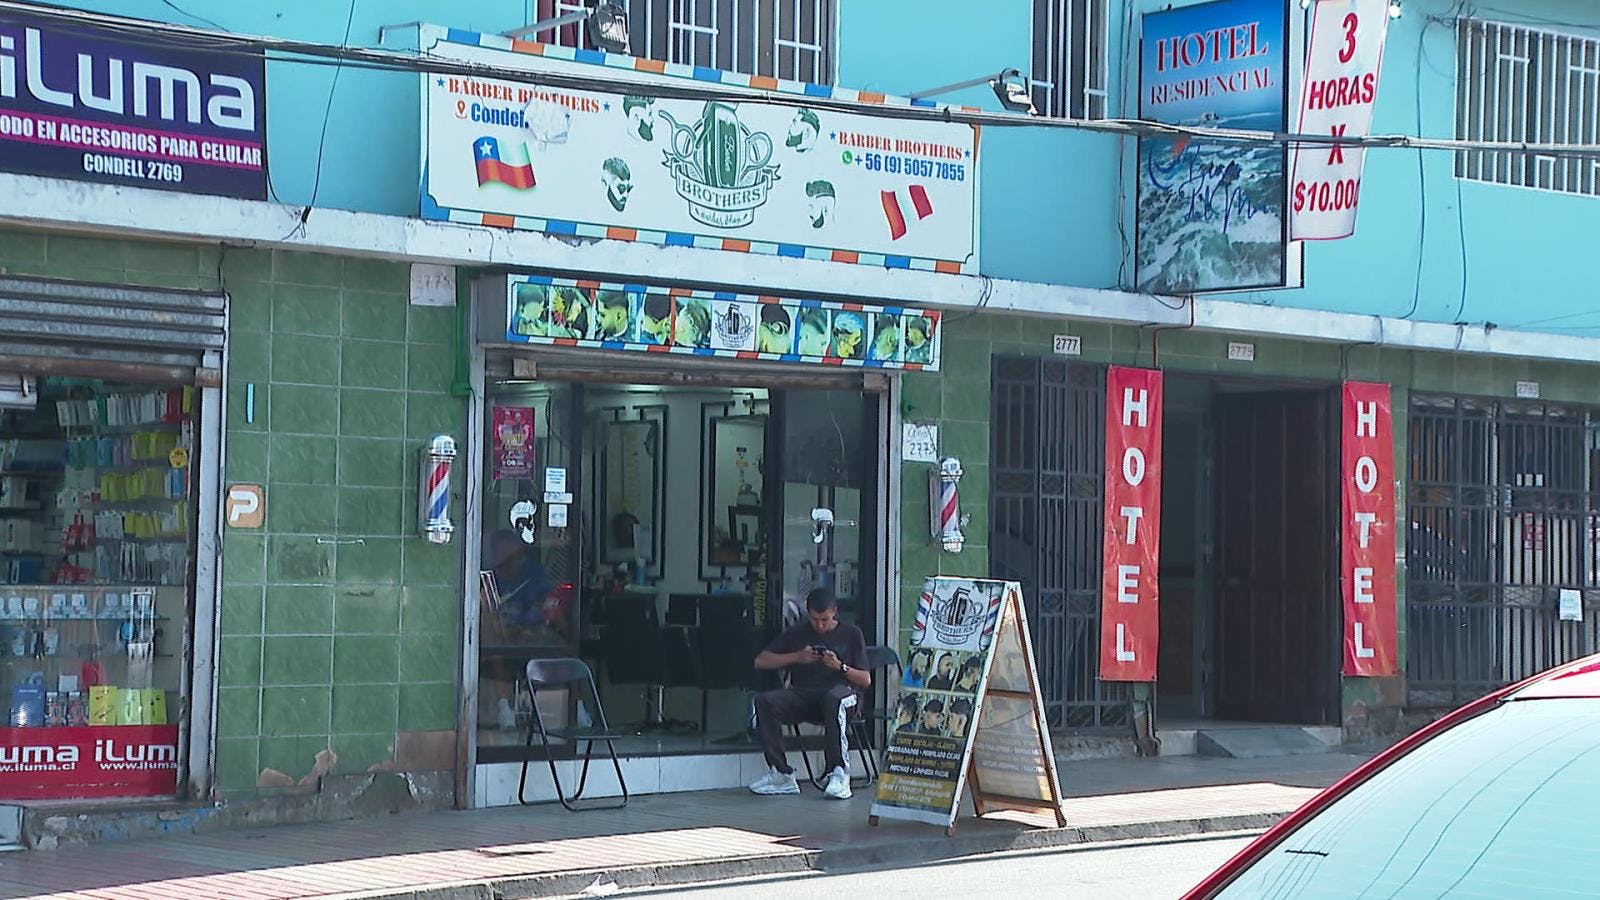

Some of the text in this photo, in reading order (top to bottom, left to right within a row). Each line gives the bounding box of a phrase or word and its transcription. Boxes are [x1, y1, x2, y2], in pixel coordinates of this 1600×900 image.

[1156, 22, 1268, 72] HOTEL
[1338, 12, 1359, 63] 3
[449, 78, 513, 101] BARBER
[1151, 67, 1274, 105] RESIDENCIAL
[1308, 73, 1374, 110] HORAS
[37, 120, 57, 140] EN
[60, 123, 157, 153] ACCESORIOS
[160, 136, 198, 159] PARA
[201, 142, 261, 166] CELULAR
[839, 131, 962, 160] BARBER BROTHERS
[83, 153, 182, 182] CONDELL 2769
[865, 153, 881, 171] 56
[884, 156, 900, 173] (9)
[681, 179, 761, 208] BROTHERS
[1056, 337, 1078, 350] 2777
[1116, 387, 1148, 661] HOTEL
[1354, 401, 1377, 658] HOTEL
